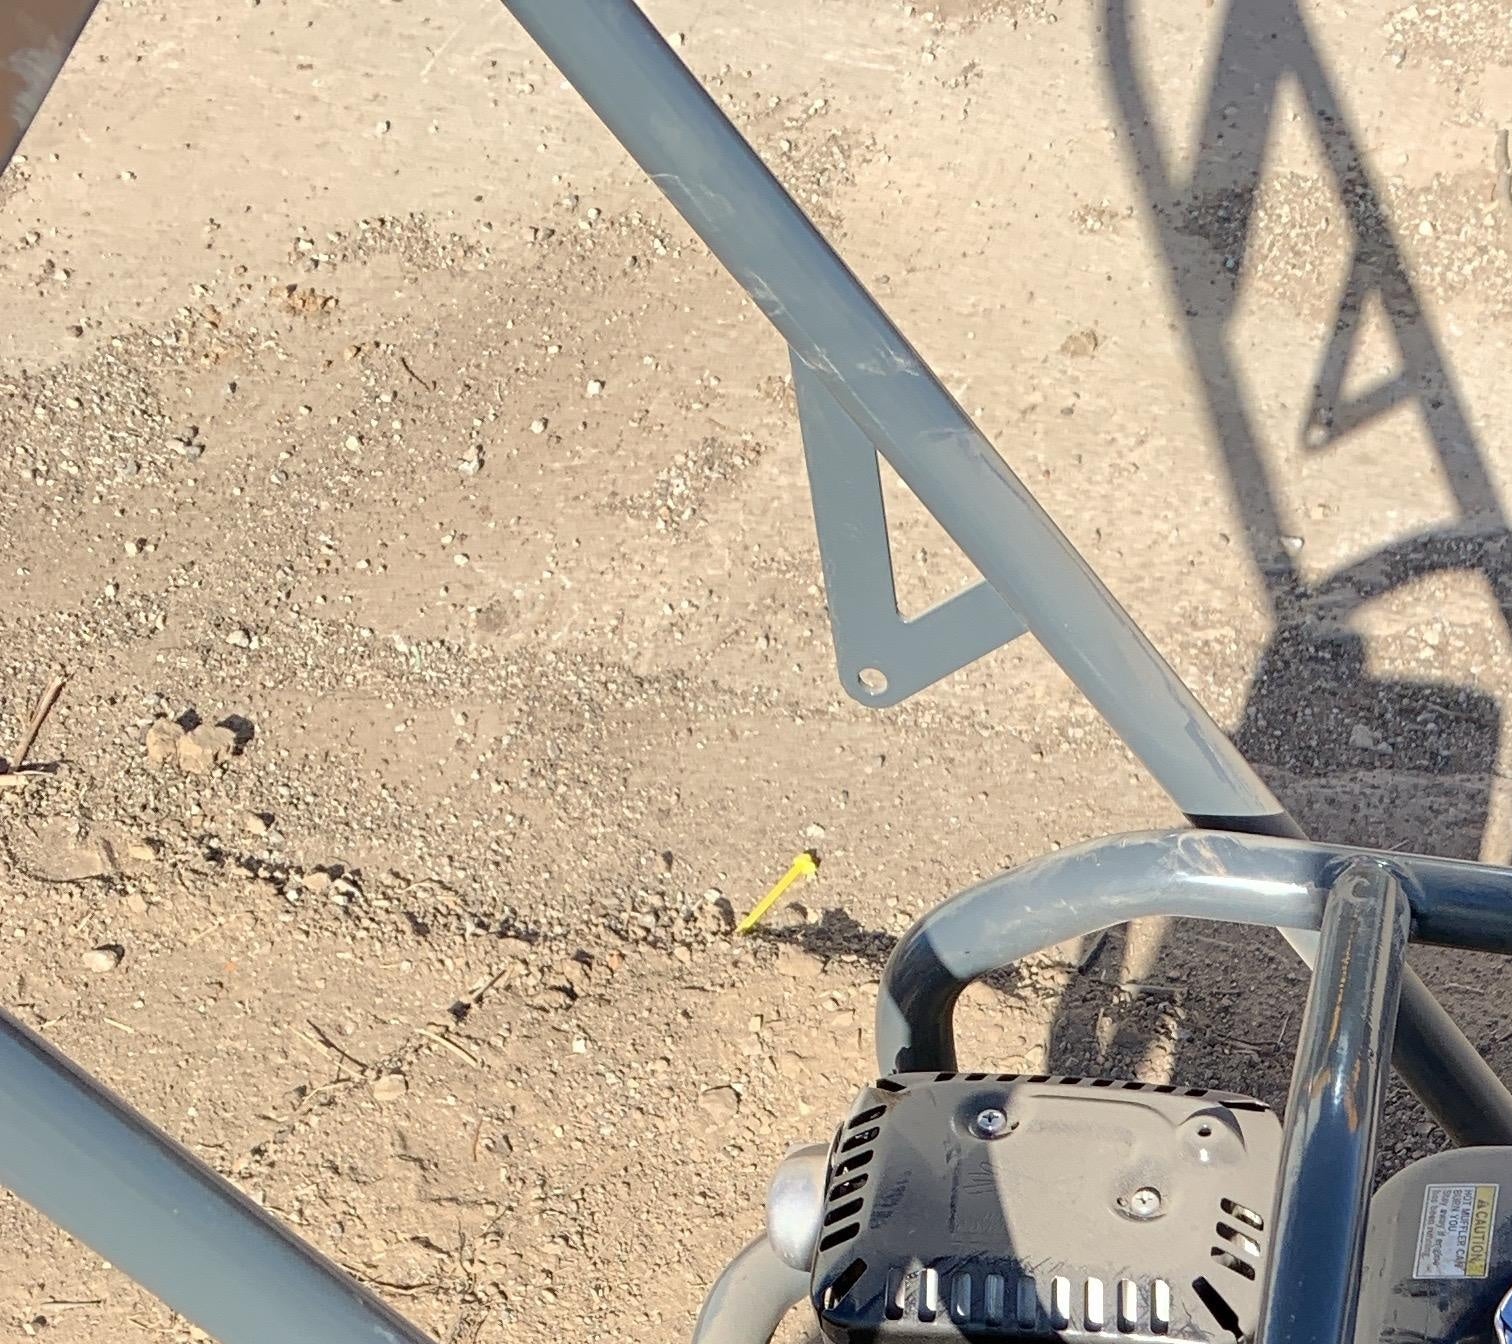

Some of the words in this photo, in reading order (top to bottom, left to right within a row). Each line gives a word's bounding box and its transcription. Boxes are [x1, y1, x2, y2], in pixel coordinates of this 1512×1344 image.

[1452, 1189, 1462, 1212] BURN
[1463, 1190, 1472, 1206] HOT
[1470, 1211, 1488, 1264] CAUTION
